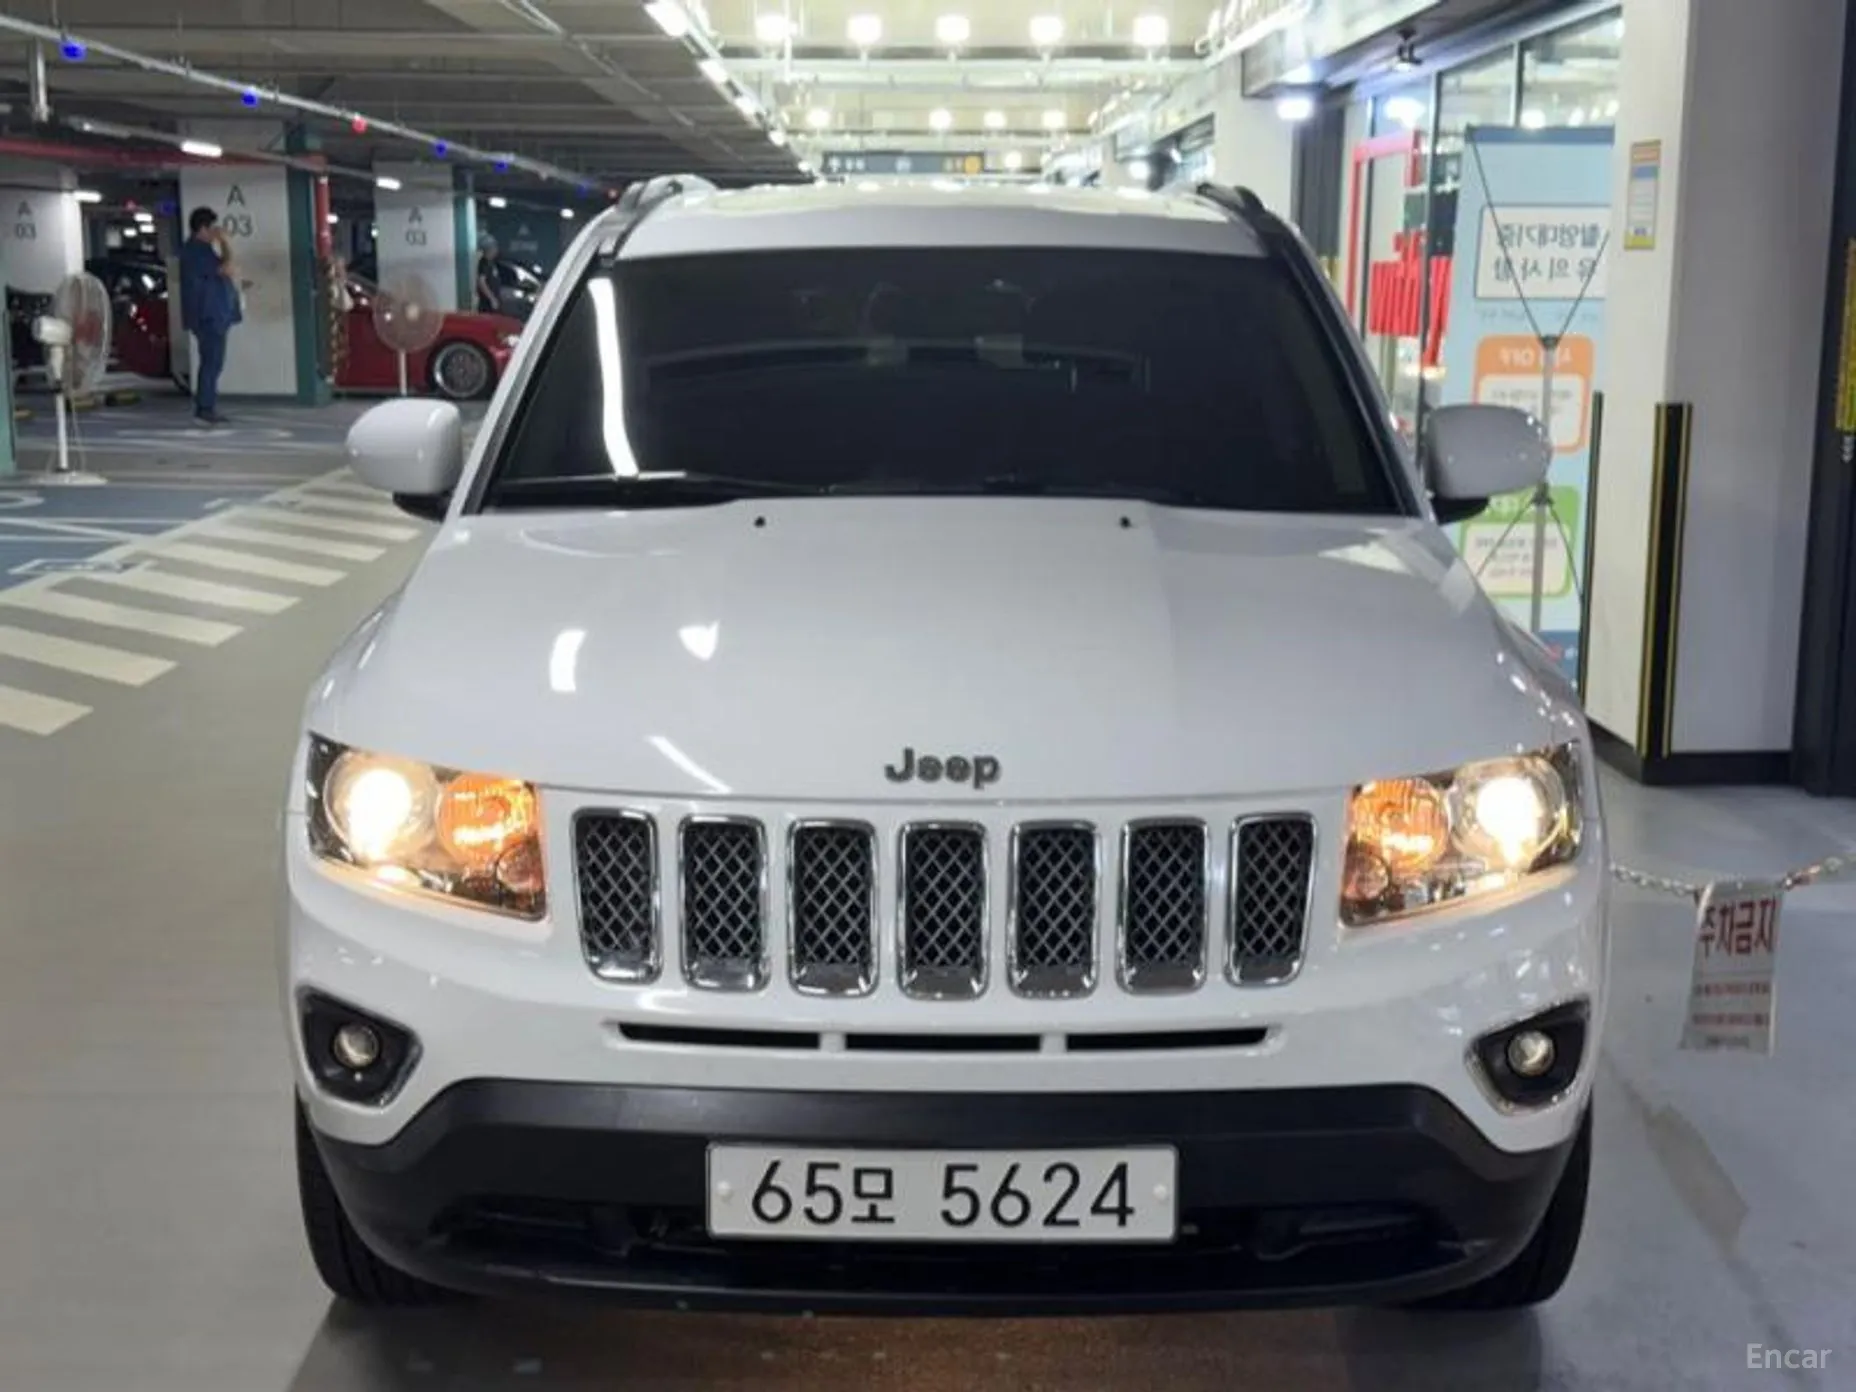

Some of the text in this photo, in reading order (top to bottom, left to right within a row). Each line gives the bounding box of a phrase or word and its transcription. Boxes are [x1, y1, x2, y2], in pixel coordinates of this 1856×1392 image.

[226, 184, 246, 207] A
[17, 200, 31, 216] A
[408, 206, 423, 224] A
[14, 223, 37, 241] 03
[223, 213, 253, 237] 03
[405, 229, 428, 247] 03
[884, 746, 1003, 791] Jeep
[751, 1159, 1135, 1228] 65모 5624
